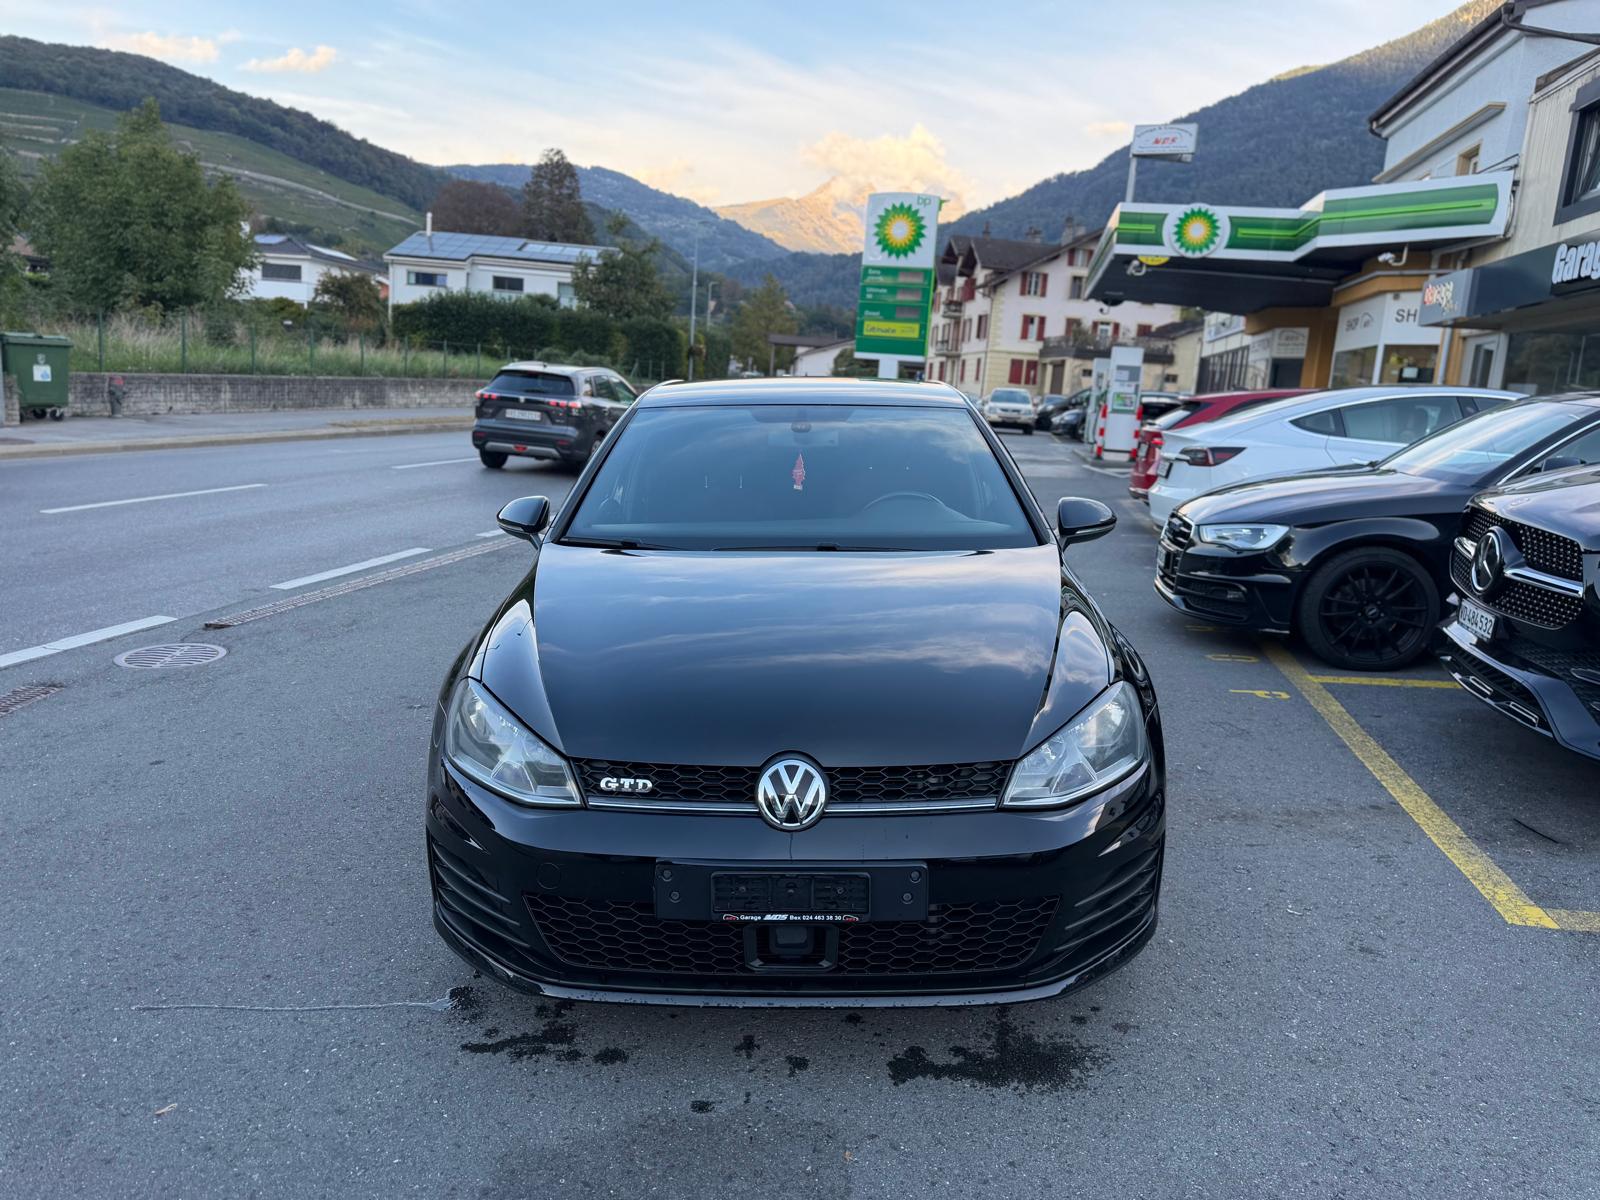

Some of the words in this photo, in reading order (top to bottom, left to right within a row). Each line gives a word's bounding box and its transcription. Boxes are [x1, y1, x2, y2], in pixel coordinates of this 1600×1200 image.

[917, 195, 931, 207] bp
[1552, 241, 1600, 284] Garag
[1395, 308, 1418, 323] SH
[600, 776, 653, 793] GTD
